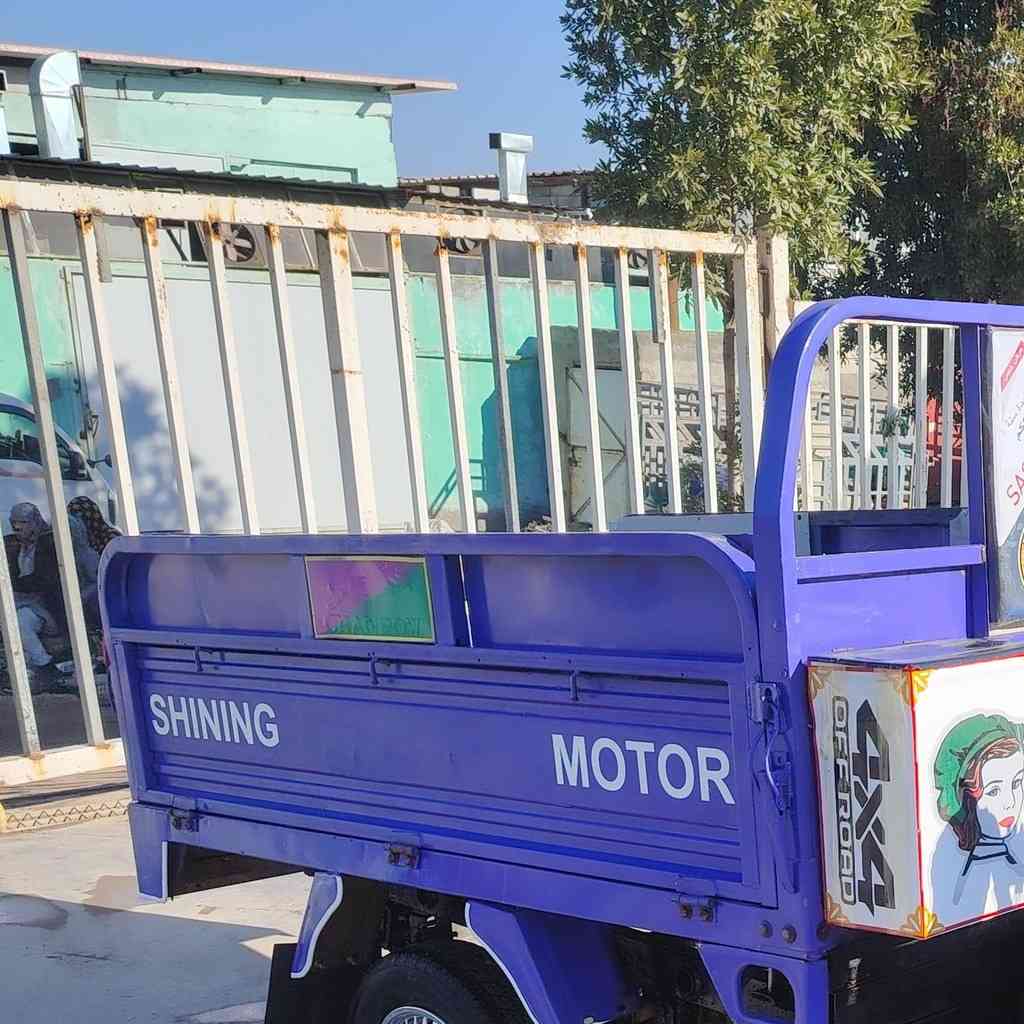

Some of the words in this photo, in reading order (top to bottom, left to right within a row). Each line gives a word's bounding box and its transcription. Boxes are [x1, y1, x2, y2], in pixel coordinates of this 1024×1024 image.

[150, 693, 280, 748] SHINING
[551, 733, 735, 805] MOTOR
[834, 699, 850, 785] OFF
[837, 791, 854, 901] ROAD
